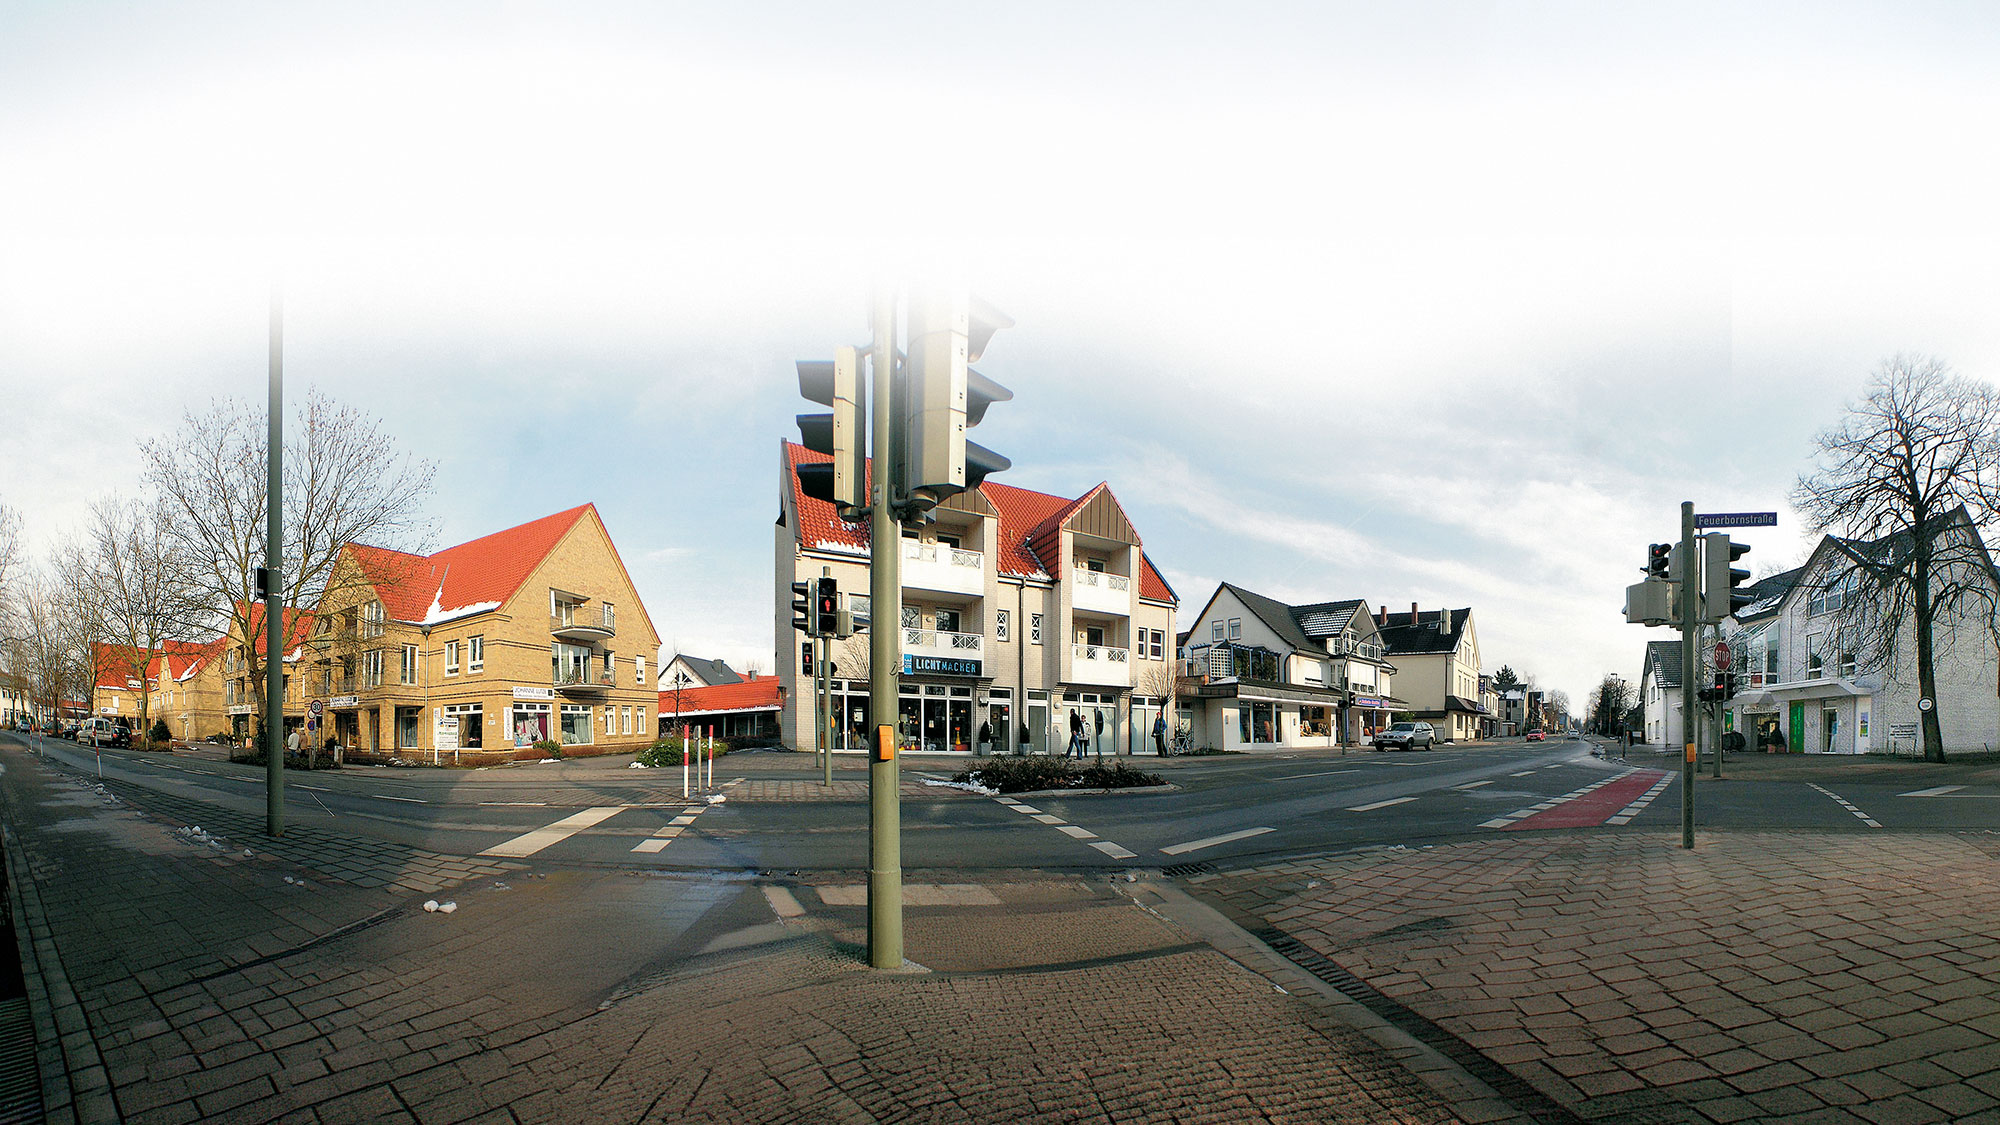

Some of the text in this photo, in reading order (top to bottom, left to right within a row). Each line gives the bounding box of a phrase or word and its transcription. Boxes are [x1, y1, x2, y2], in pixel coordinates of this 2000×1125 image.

[1698, 514, 1773, 525] Feuerbornstraße
[1715, 650, 1730, 662] STOP
[915, 658, 976, 673] LICHTMACHER
